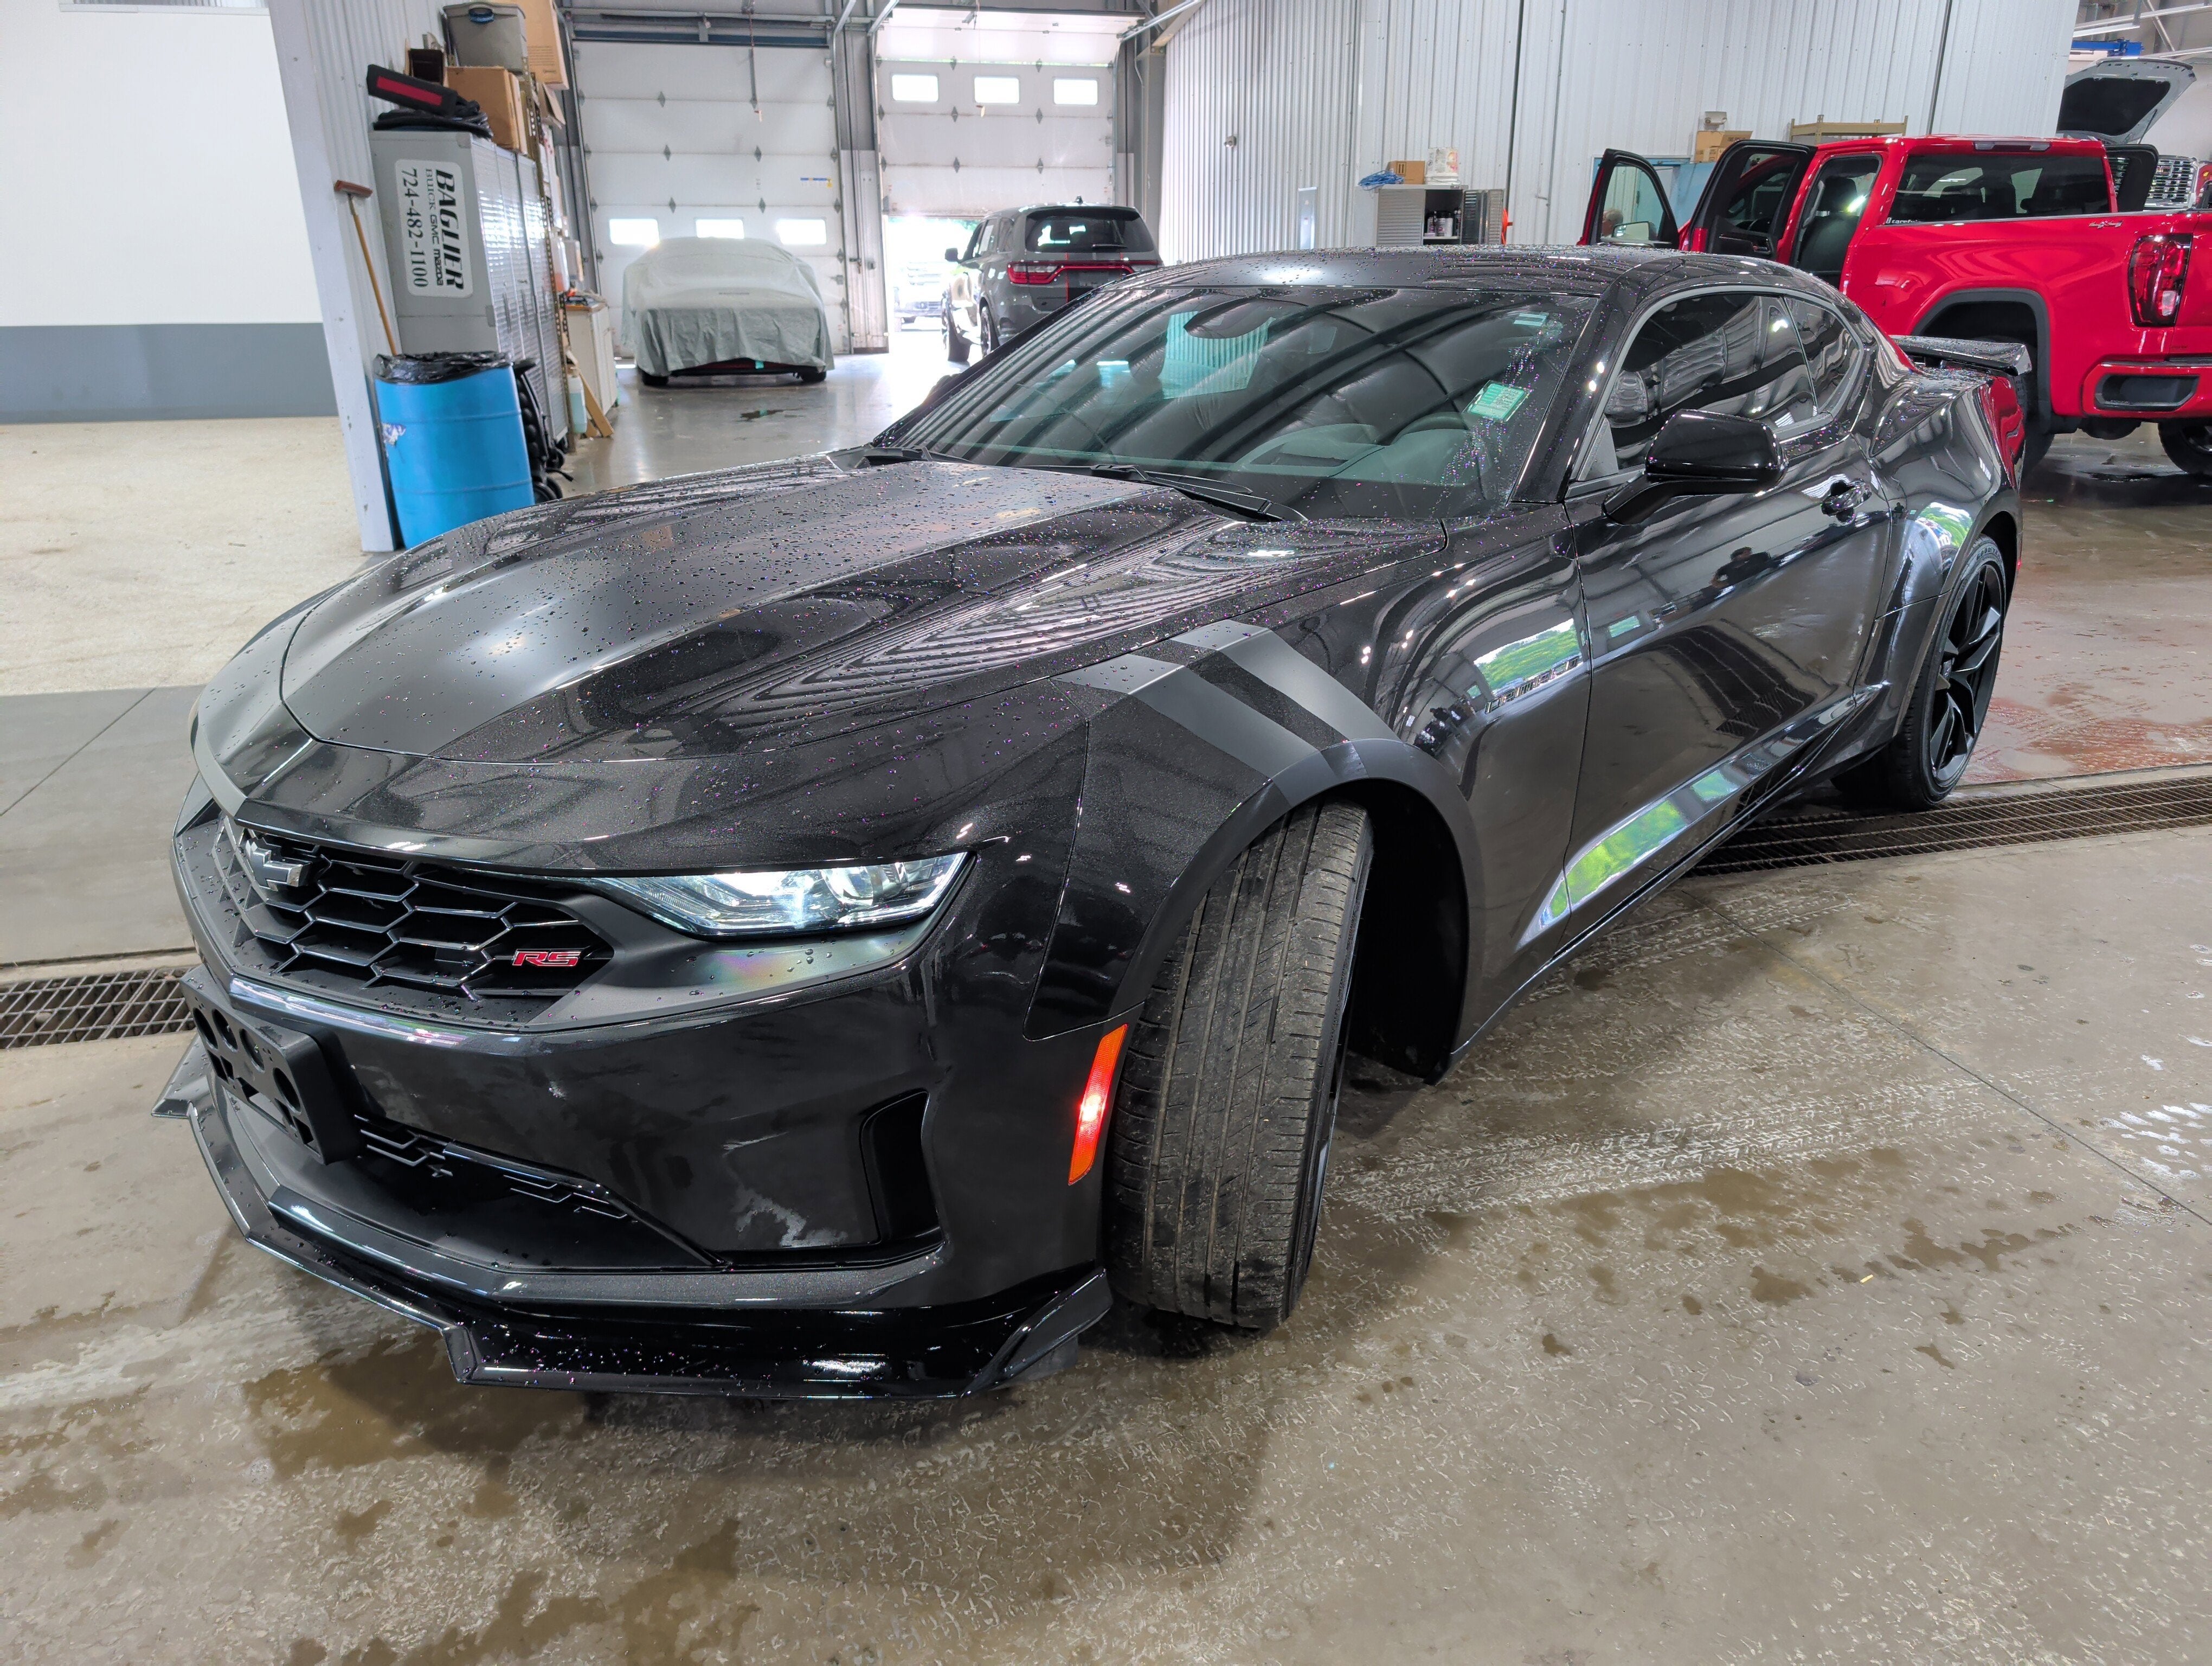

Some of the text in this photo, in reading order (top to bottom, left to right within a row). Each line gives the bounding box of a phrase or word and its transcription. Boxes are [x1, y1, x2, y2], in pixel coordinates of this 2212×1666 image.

[401, 168, 428, 287] 724-482-1100
[425, 169, 444, 286] BUICK GMC mazda
[435, 169, 464, 290] BAGLIER
[511, 951, 582, 966] RS
